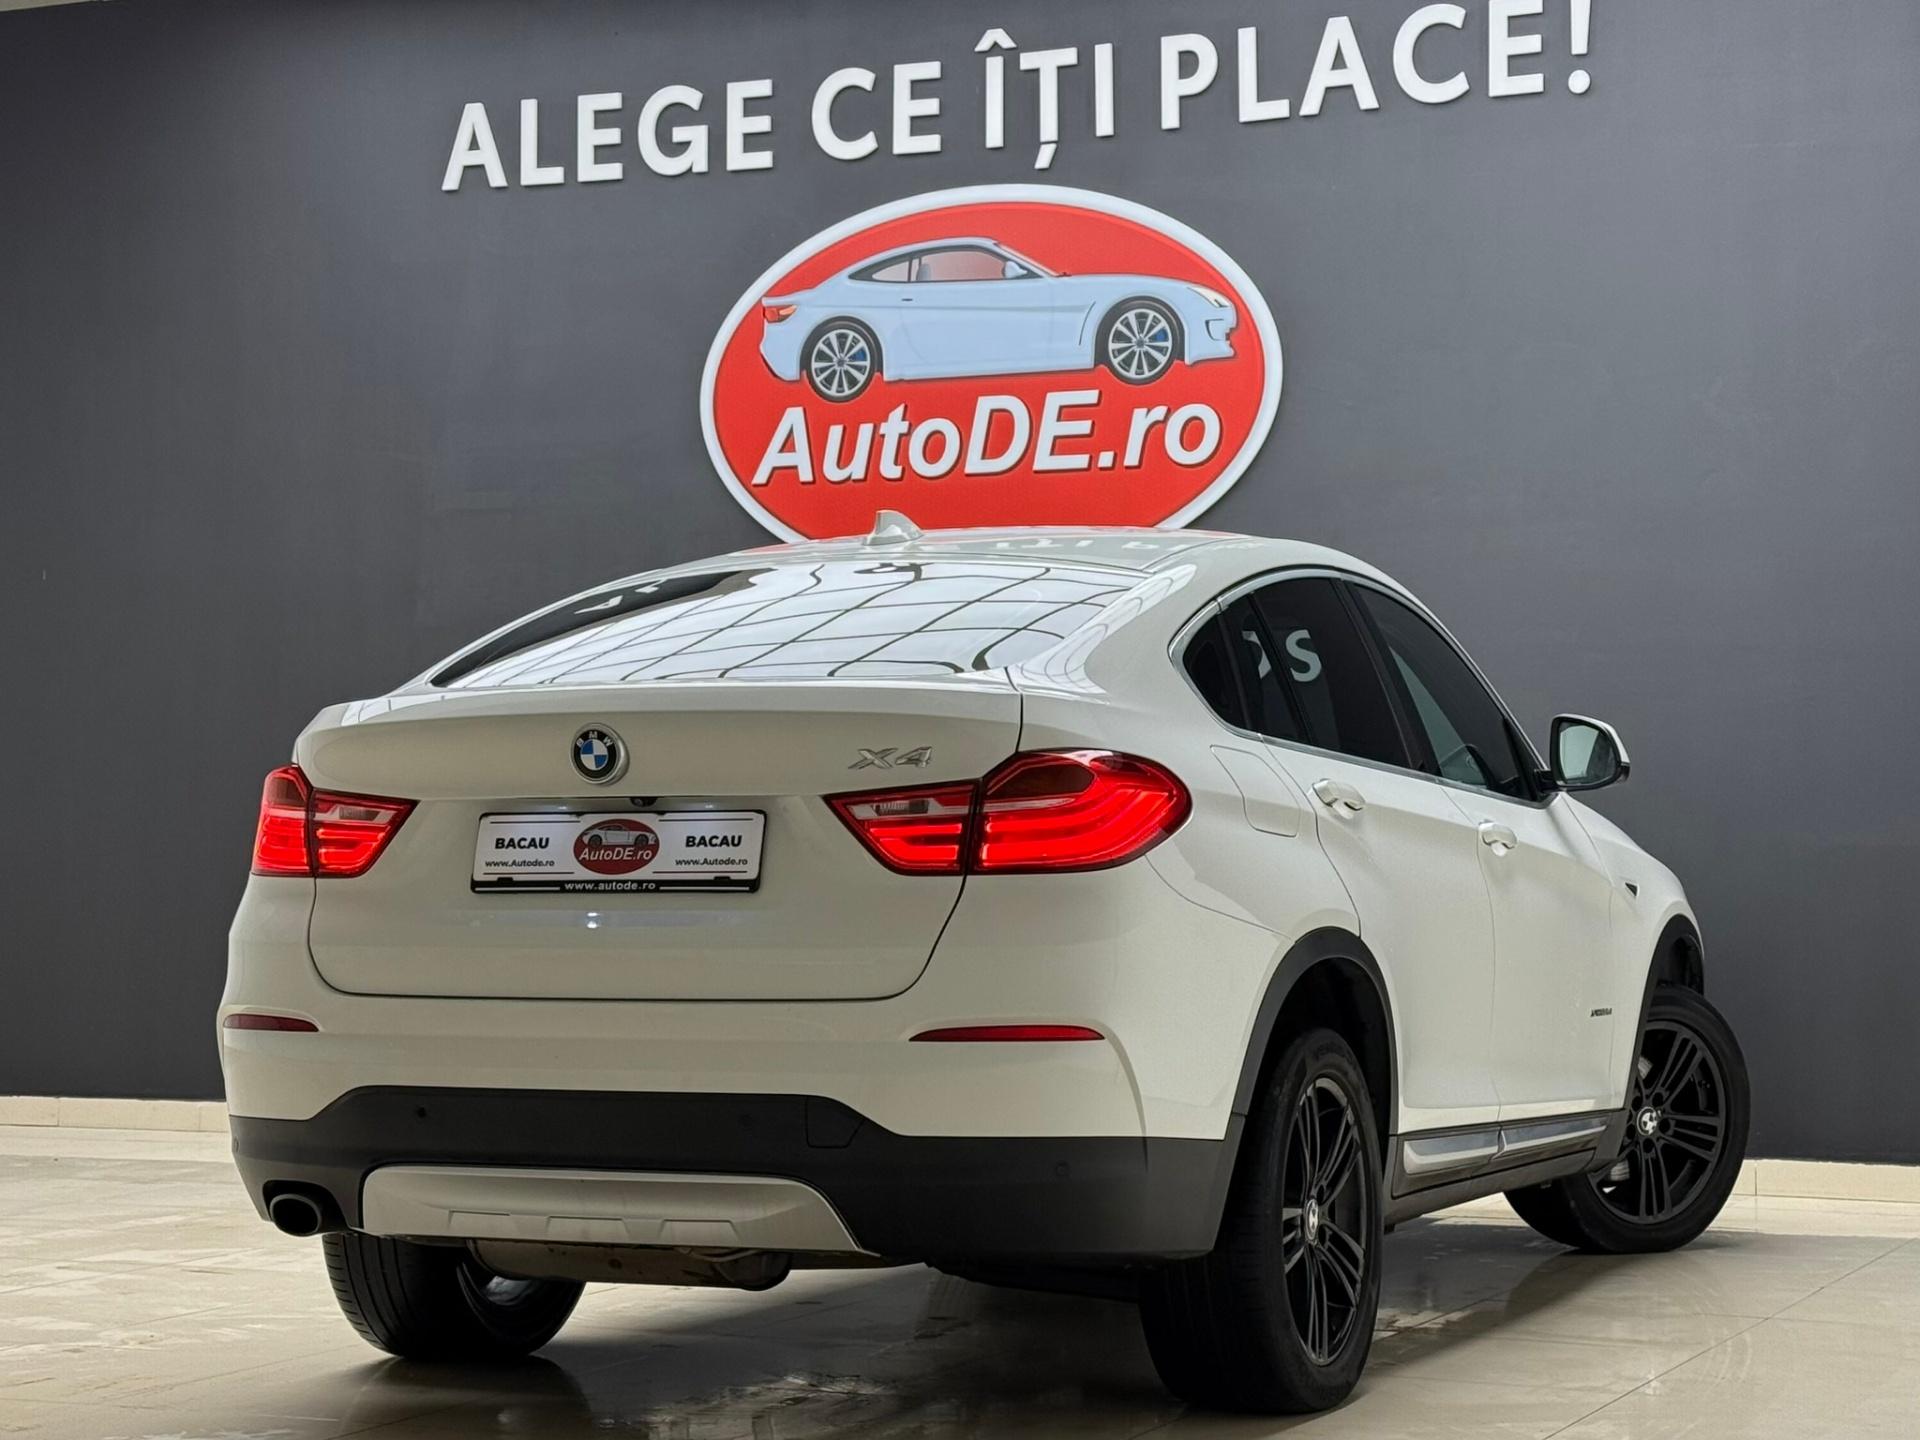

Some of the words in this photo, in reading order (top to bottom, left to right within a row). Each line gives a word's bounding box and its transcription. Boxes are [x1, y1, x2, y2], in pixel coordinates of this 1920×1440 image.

[441, 79, 774, 191] ALEGE
[811, 60, 942, 161] CE
[1160, 0, 1593, 131] PLACE!
[752, 388, 1222, 486] AutoDE.ro
[848, 746, 933, 771] X4
[495, 837, 550, 850] BACAU
[685, 835, 742, 848] BACAU
[578, 847, 653, 861] AutoDE.ro
[485, 859, 555, 868] www.Autode.ro
[675, 858, 748, 866] www.Autode.ro
[564, 881, 656, 891] www.autode.ro
